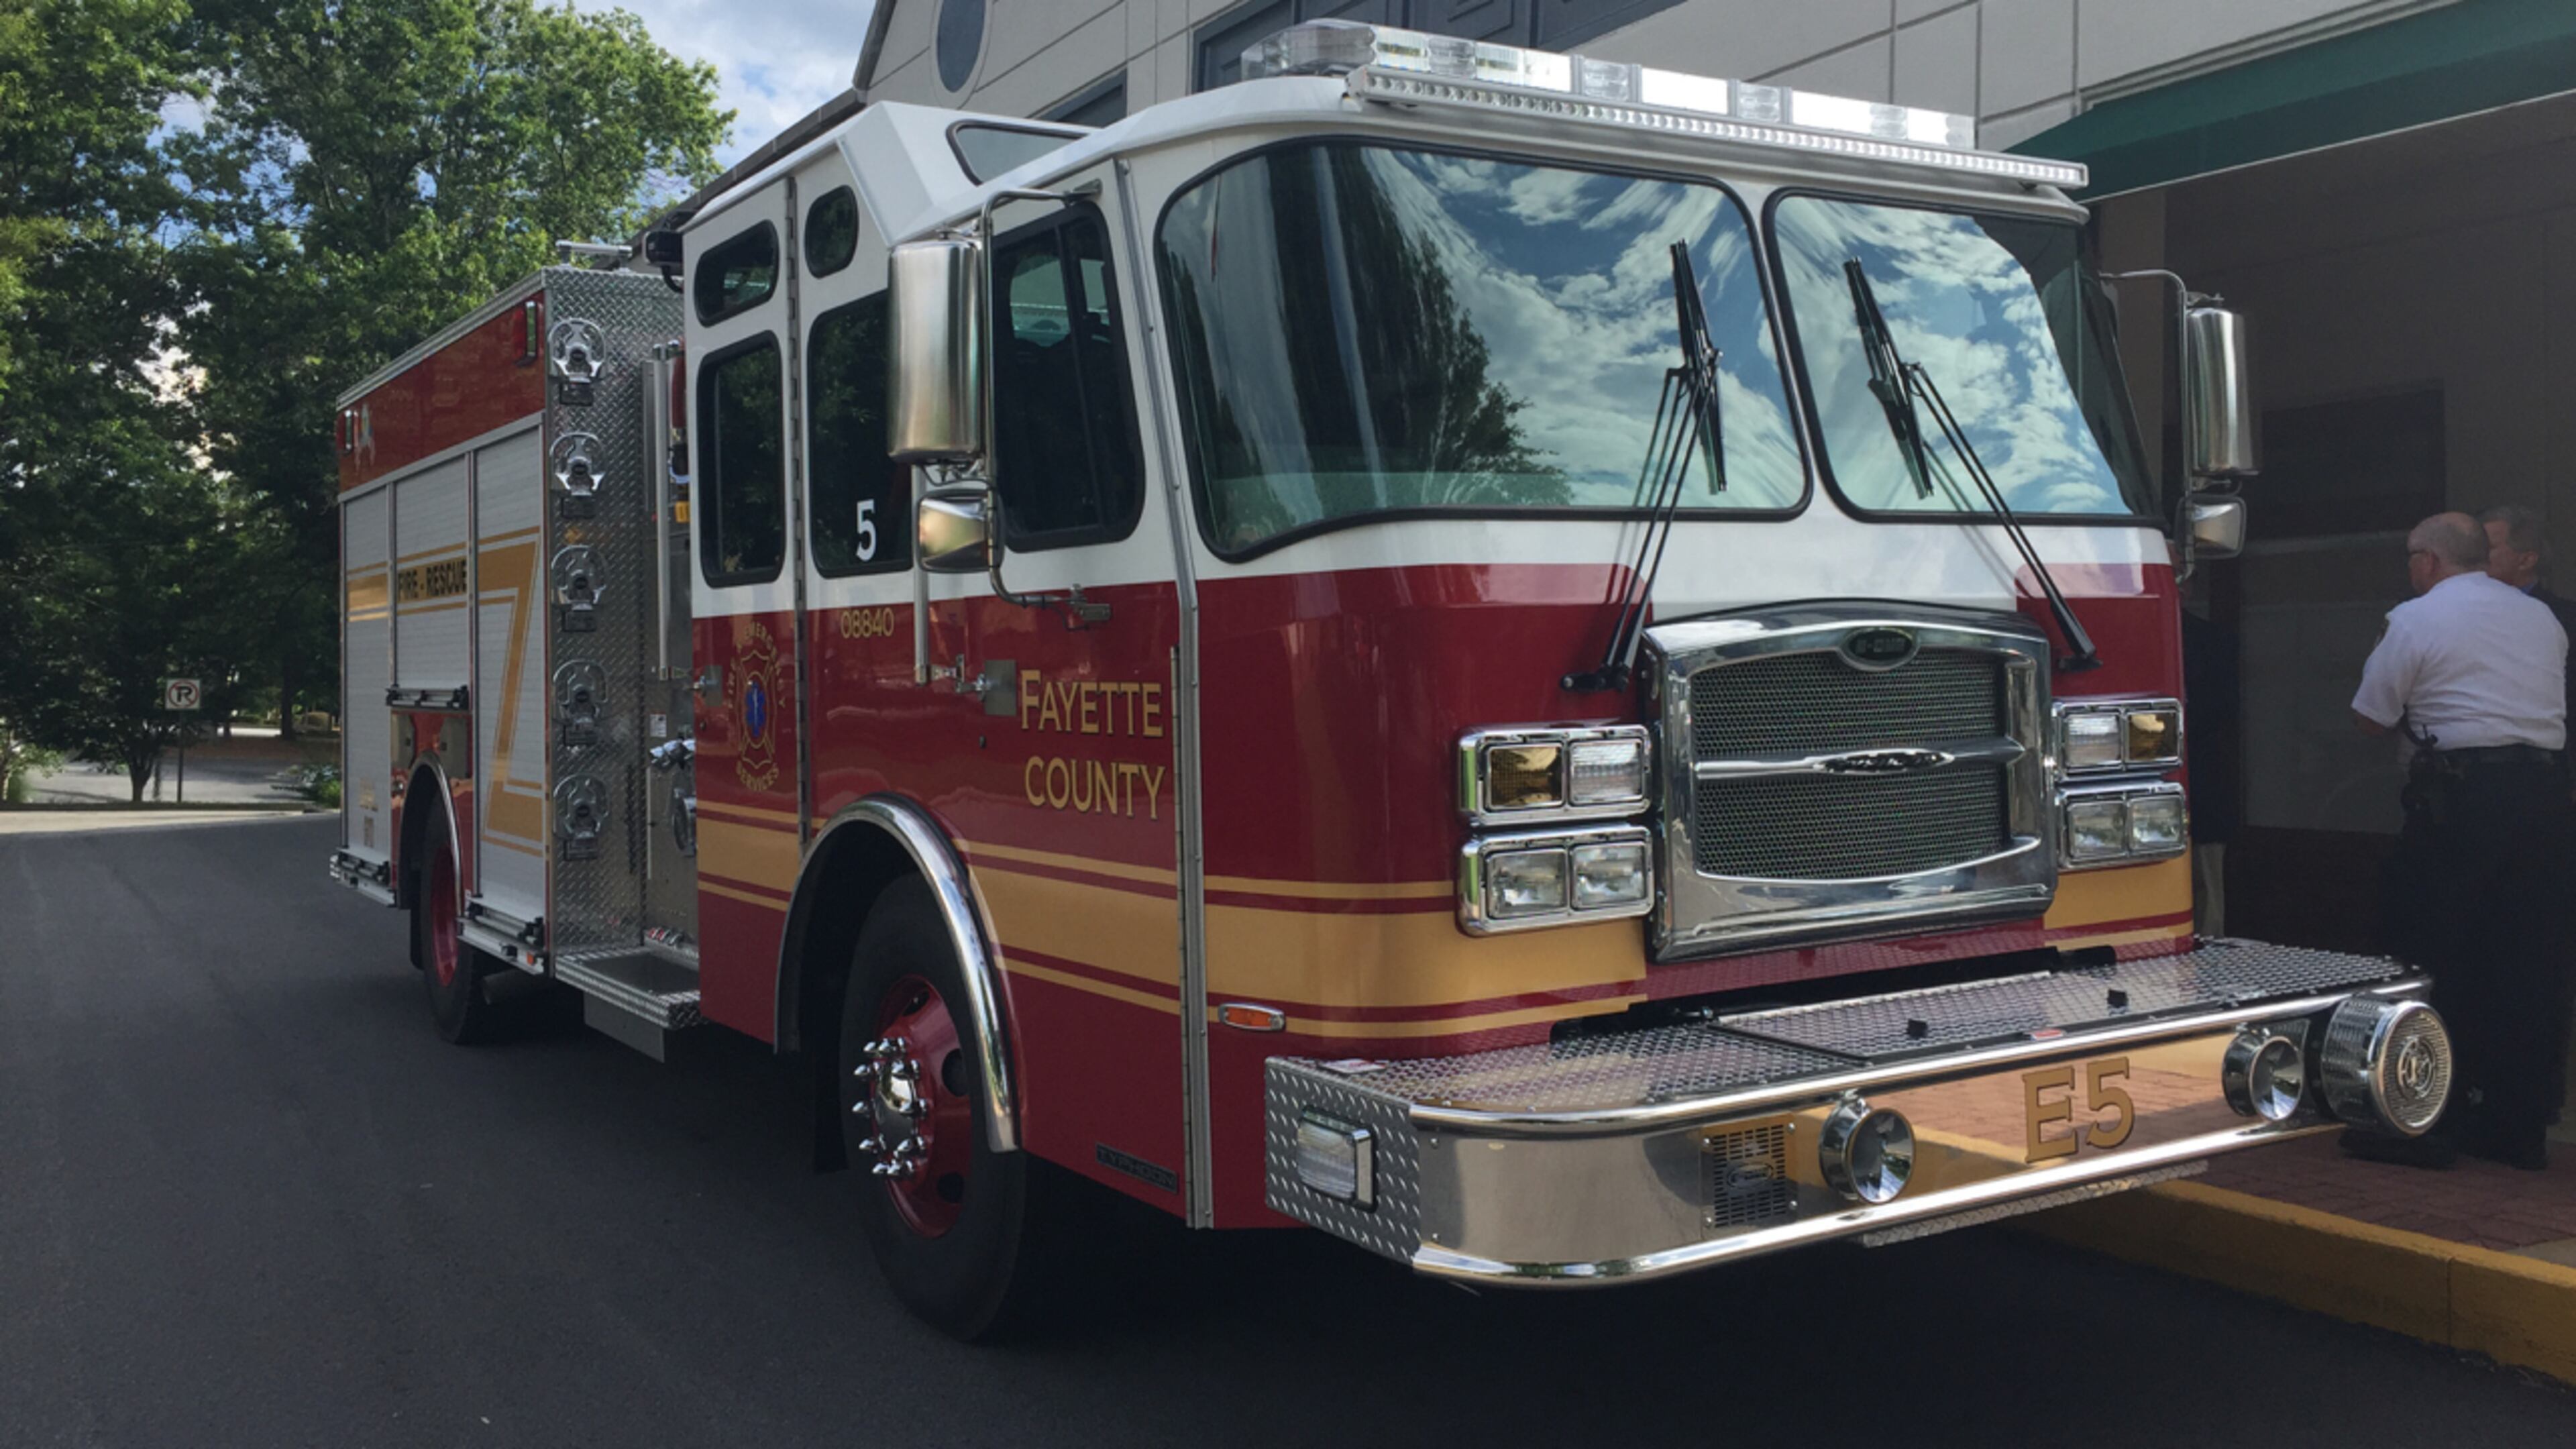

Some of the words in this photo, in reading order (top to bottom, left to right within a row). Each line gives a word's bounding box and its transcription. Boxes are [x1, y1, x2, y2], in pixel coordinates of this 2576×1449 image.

[855, 498, 877, 562] 5
[398, 570, 418, 601] FIRE
[426, 559, 467, 596] RESCUE
[840, 607, 894, 639] 08840
[1020, 669, 1164, 737] FAYETTE
[1025, 755, 1166, 820] COUNTY
[2022, 1057, 2135, 1163] E5
